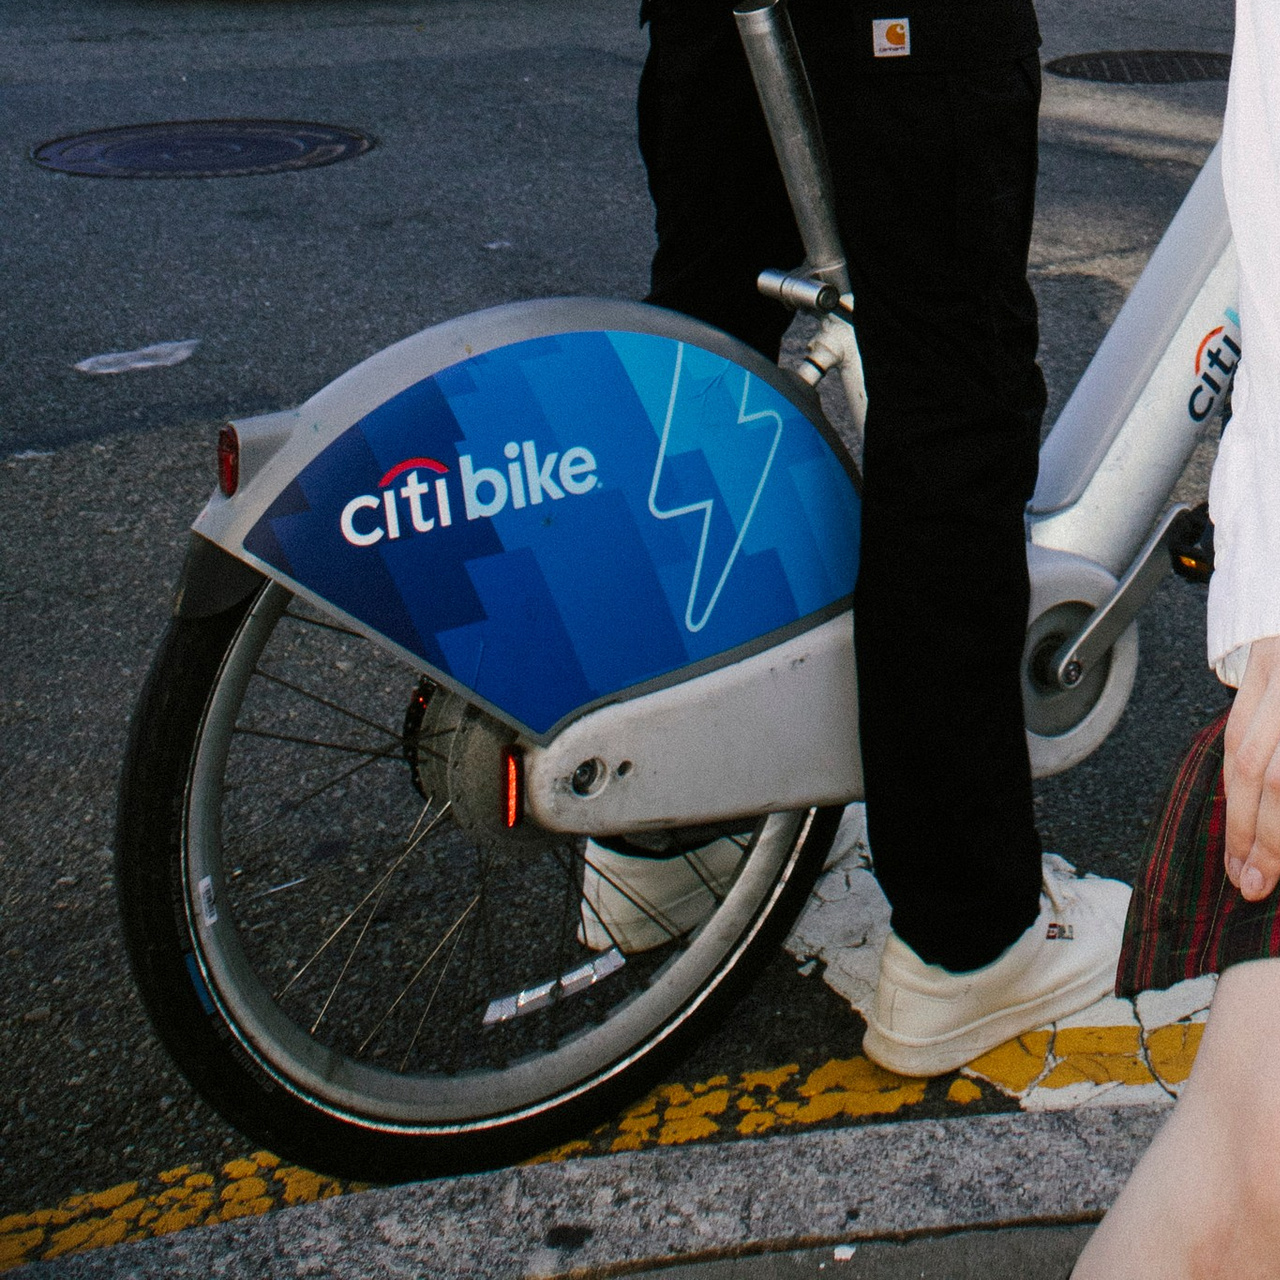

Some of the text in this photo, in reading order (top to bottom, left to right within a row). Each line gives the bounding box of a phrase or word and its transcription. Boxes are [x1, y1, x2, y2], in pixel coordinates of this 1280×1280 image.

[1188, 326, 1242, 422] citi
[340, 440, 598, 546] citi bike
